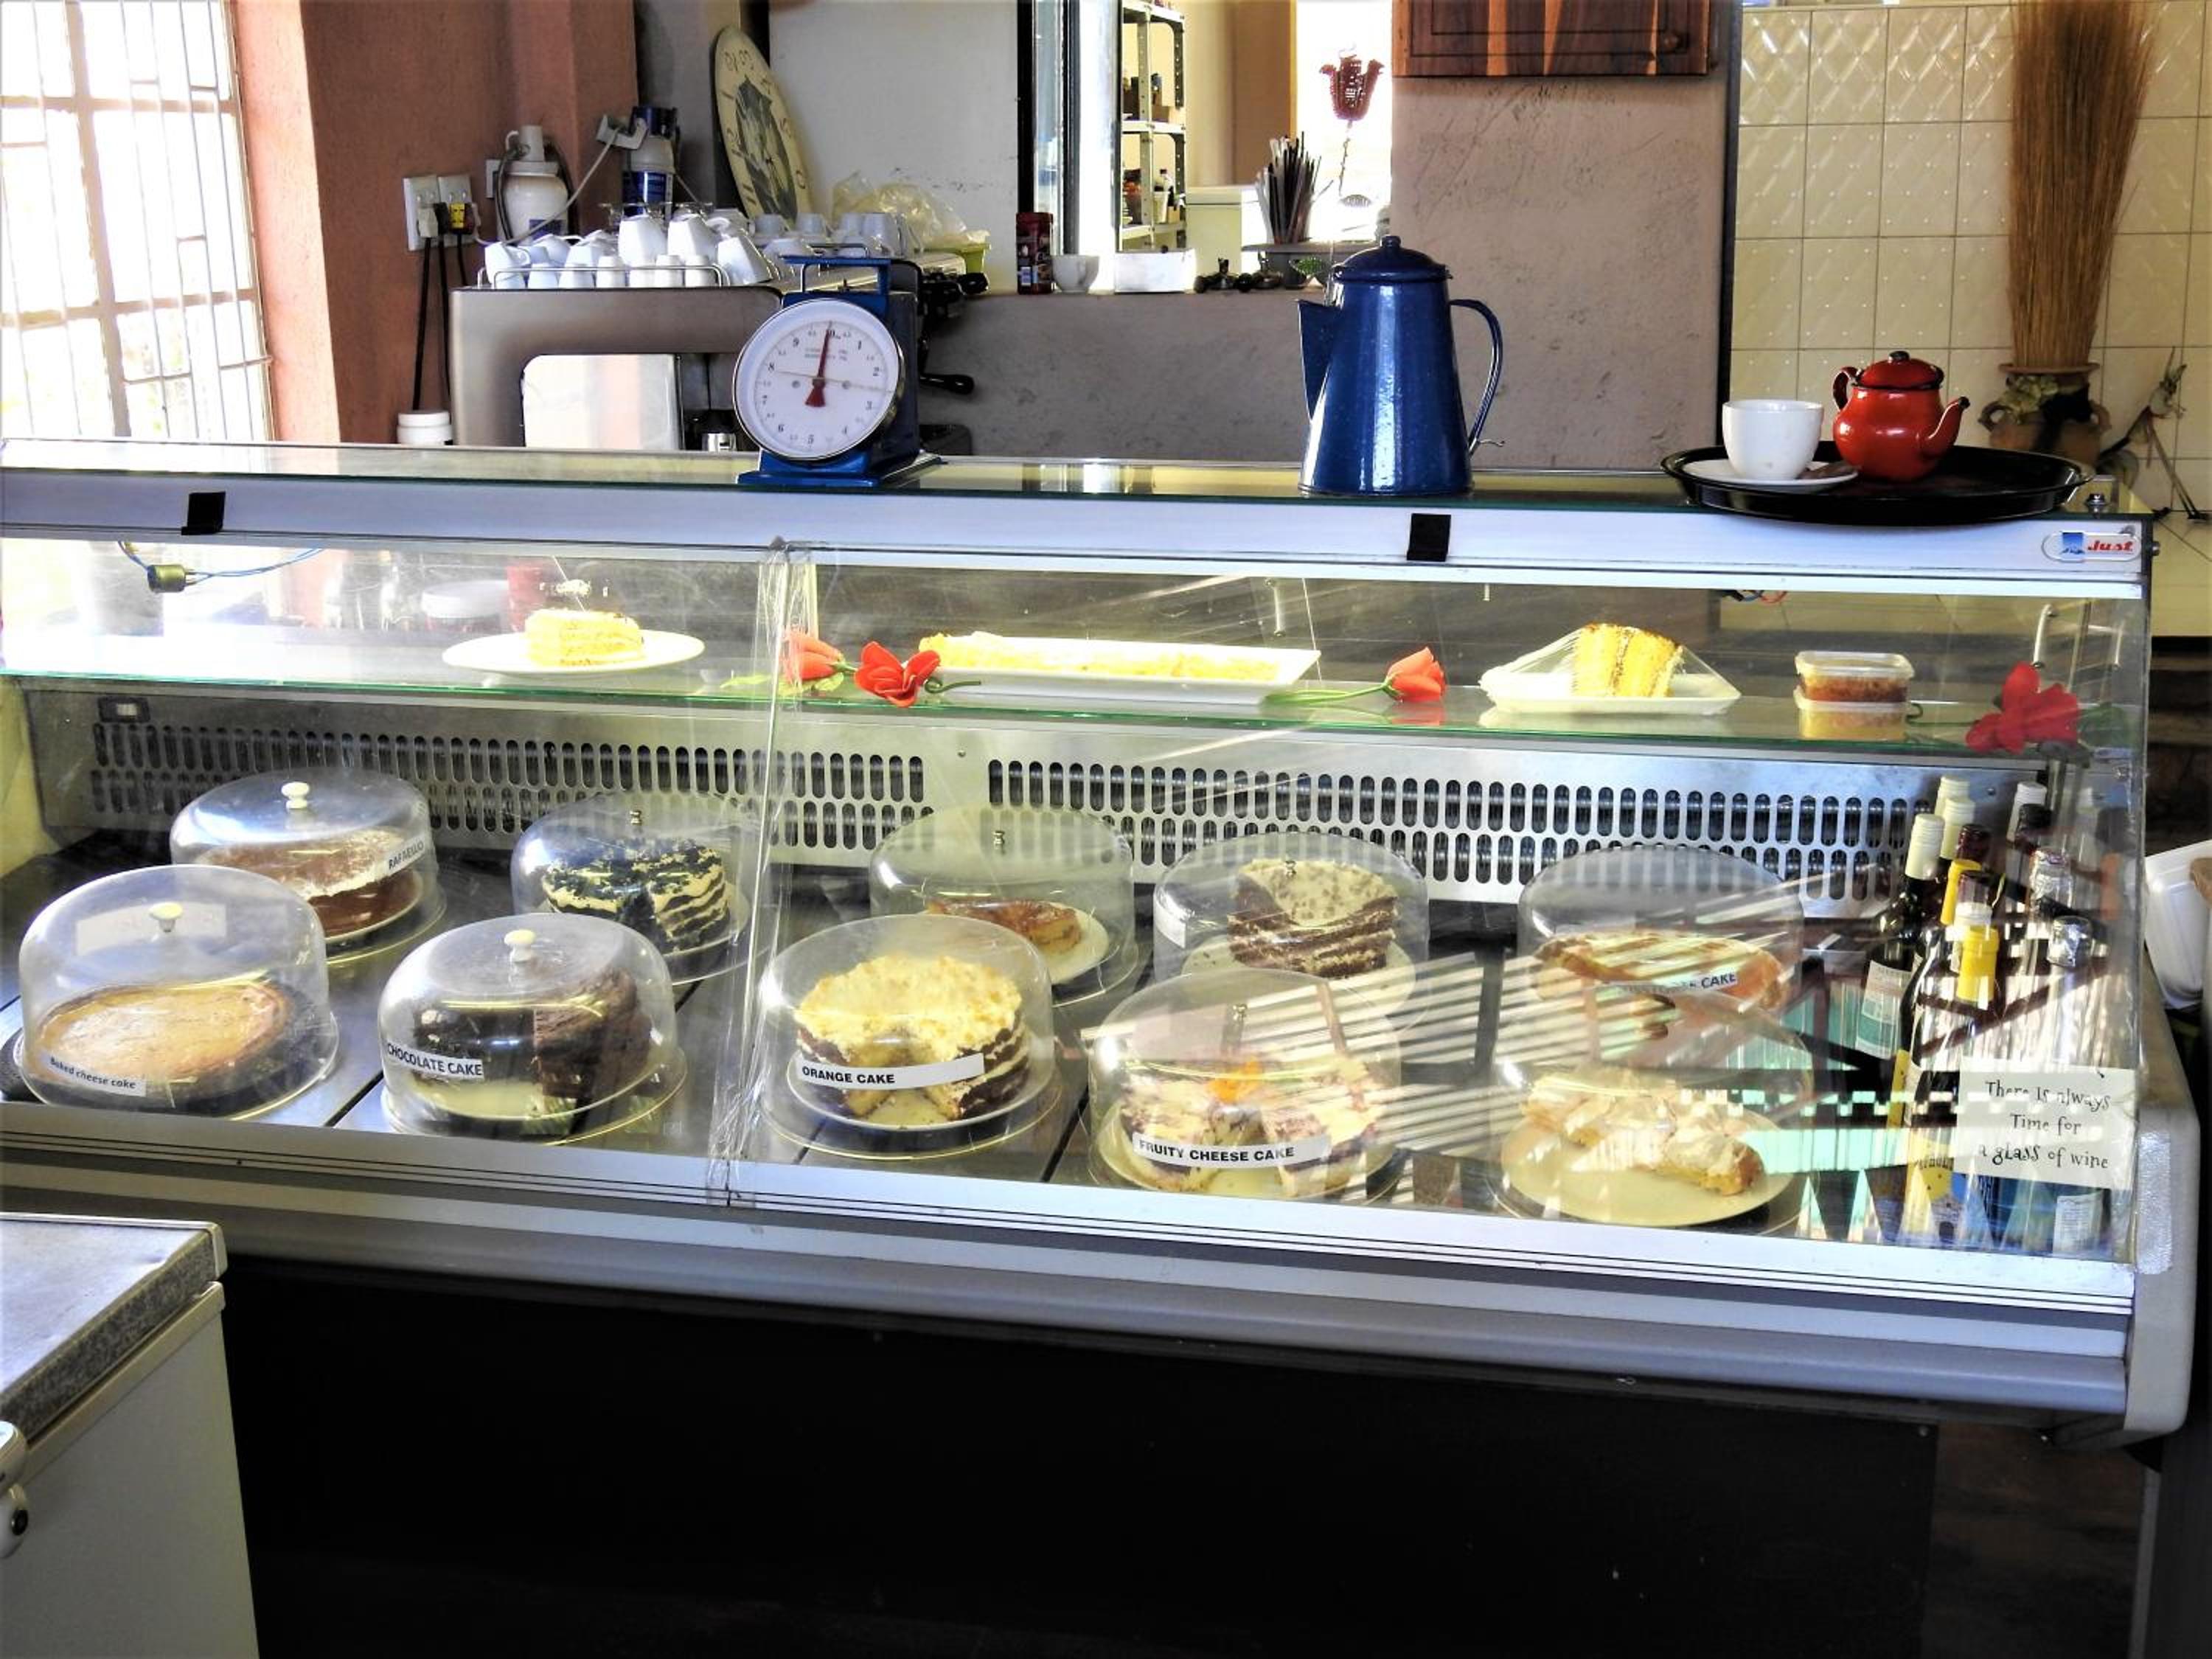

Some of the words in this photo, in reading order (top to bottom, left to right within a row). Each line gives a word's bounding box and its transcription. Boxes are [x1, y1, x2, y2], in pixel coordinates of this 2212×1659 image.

[2087, 540, 2134, 552] Just
[1700, 972, 1737, 990] CAKE
[386, 1043, 445, 1074] CHOCOLATE
[448, 1062, 483, 1077] CAKE
[111, 1077, 136, 1090] cake
[801, 1065, 852, 1084] ORANGE
[857, 1073, 896, 1085] CAKE
[1985, 1079, 2028, 1099] There
[2010, 1113, 2050, 1131] Time
[2058, 1116, 2081, 1136] for
[1138, 1138, 1186, 1159] FRUITY
[1189, 1148, 1250, 1162] CHEESE
[1253, 1147, 1295, 1161] CAKE
[1992, 1143, 2041, 1166] glass
[2048, 1147, 2066, 1168] of
[2070, 1150, 2109, 1169] wine
